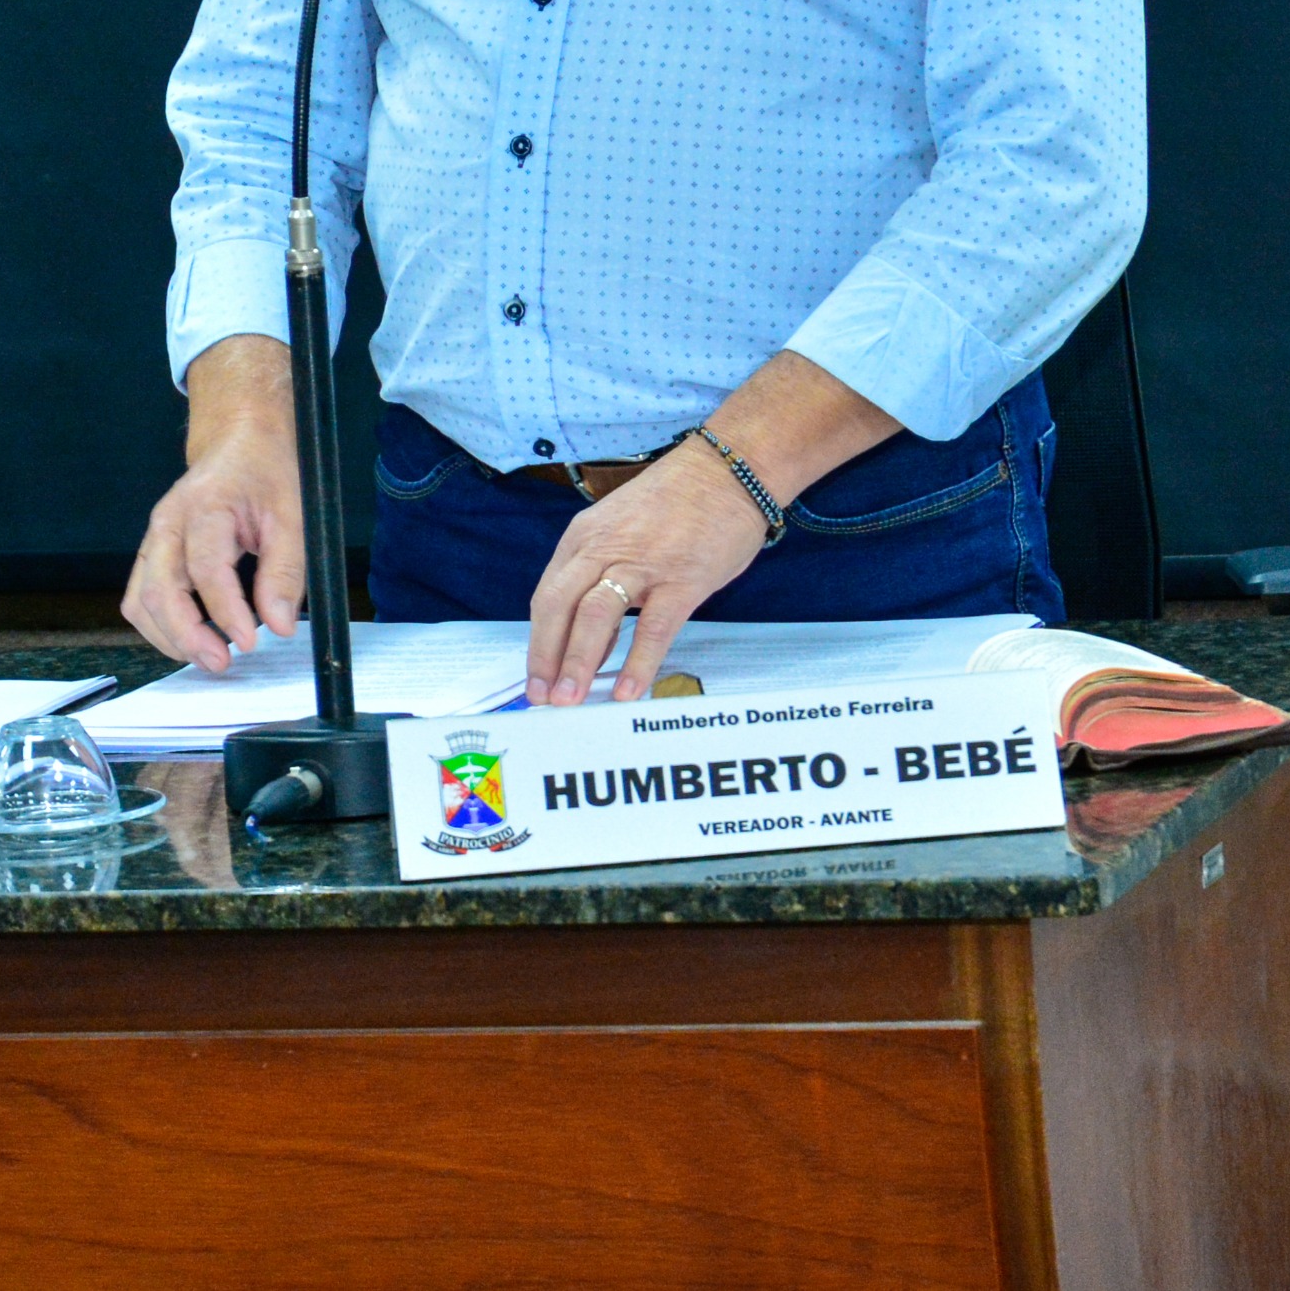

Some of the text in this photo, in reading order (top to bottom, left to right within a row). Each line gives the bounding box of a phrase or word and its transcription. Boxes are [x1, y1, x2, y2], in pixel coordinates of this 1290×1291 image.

[632, 697, 934, 733] Humberto Donizete Ferreira
[543, 726, 1038, 810] HUMBERTO - BEBÉ
[699, 815, 804, 836] VEREADOR
[820, 808, 893, 827] AVANTE
